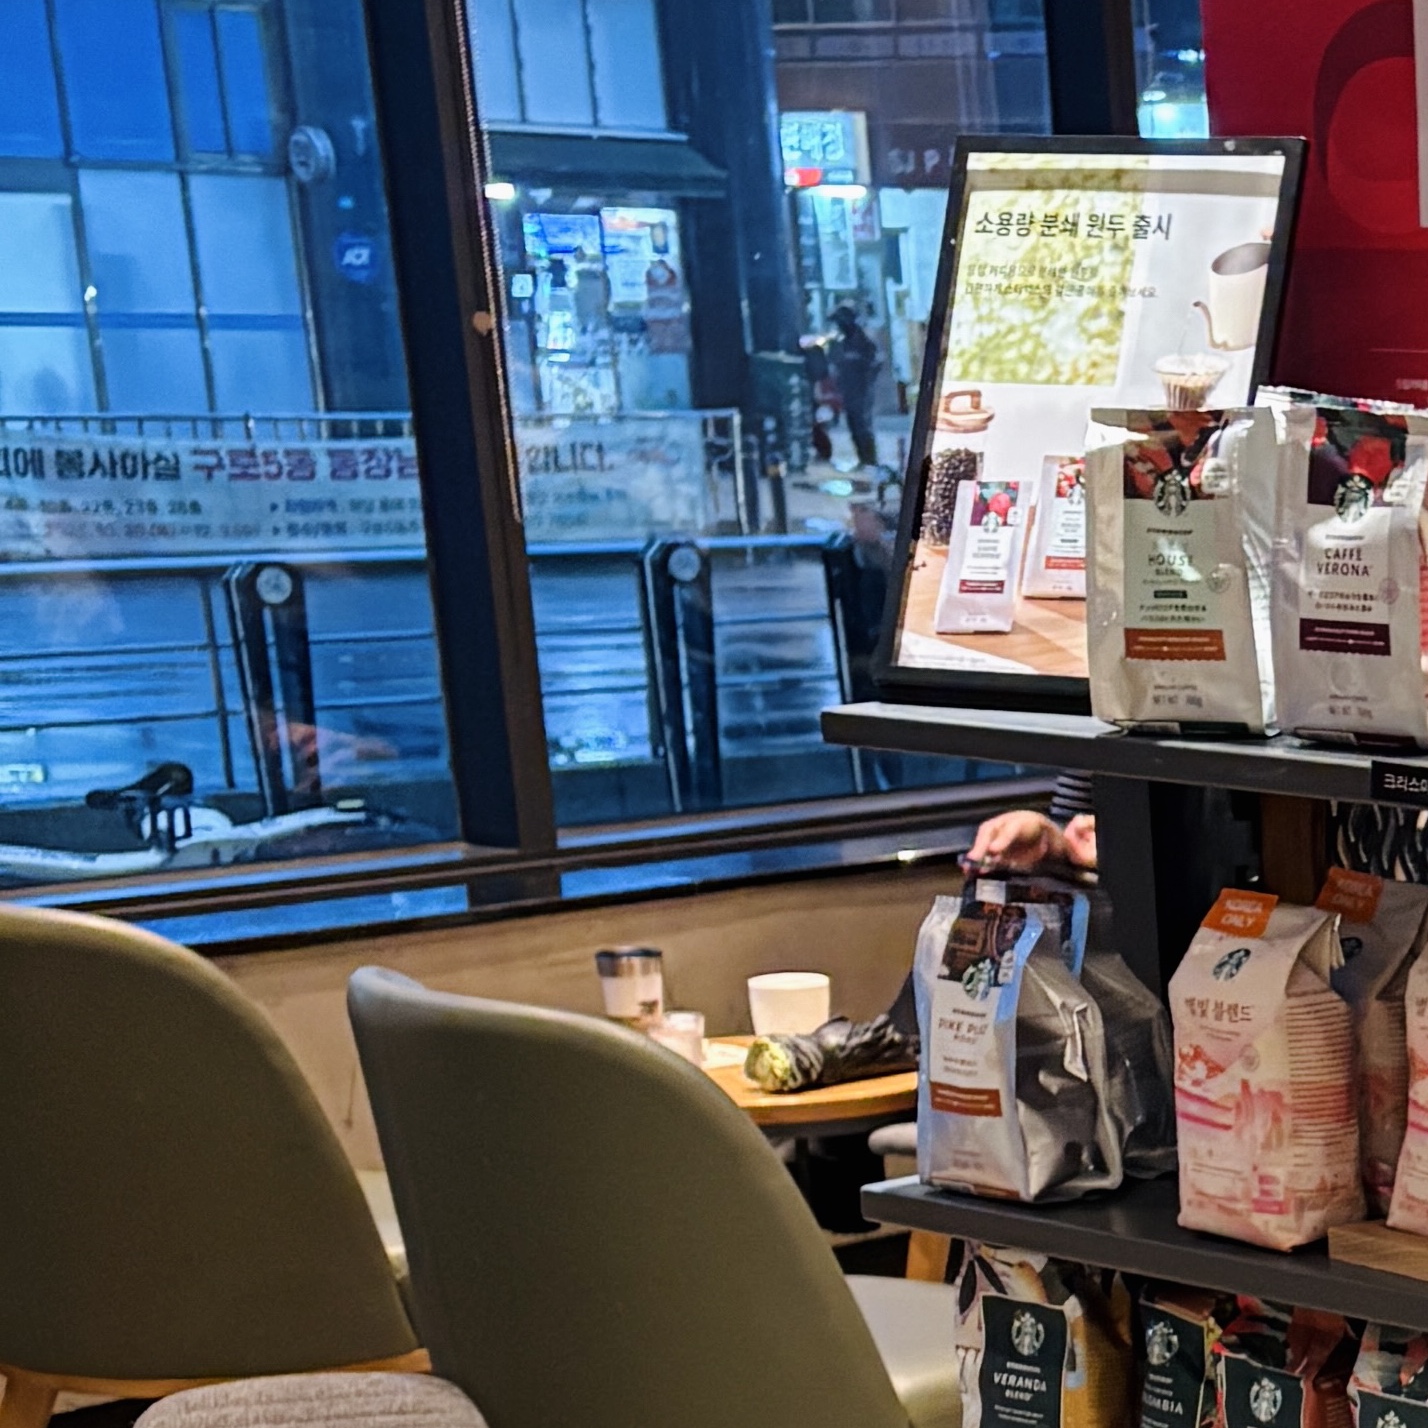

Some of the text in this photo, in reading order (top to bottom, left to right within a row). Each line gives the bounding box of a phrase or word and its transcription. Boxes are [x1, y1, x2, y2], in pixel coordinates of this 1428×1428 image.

[975, 211, 1173, 240] 소용량 분쇄 원두 출시
[1317, 562, 1370, 577] VERONA
[993, 1372, 1047, 1392] VERANDA
